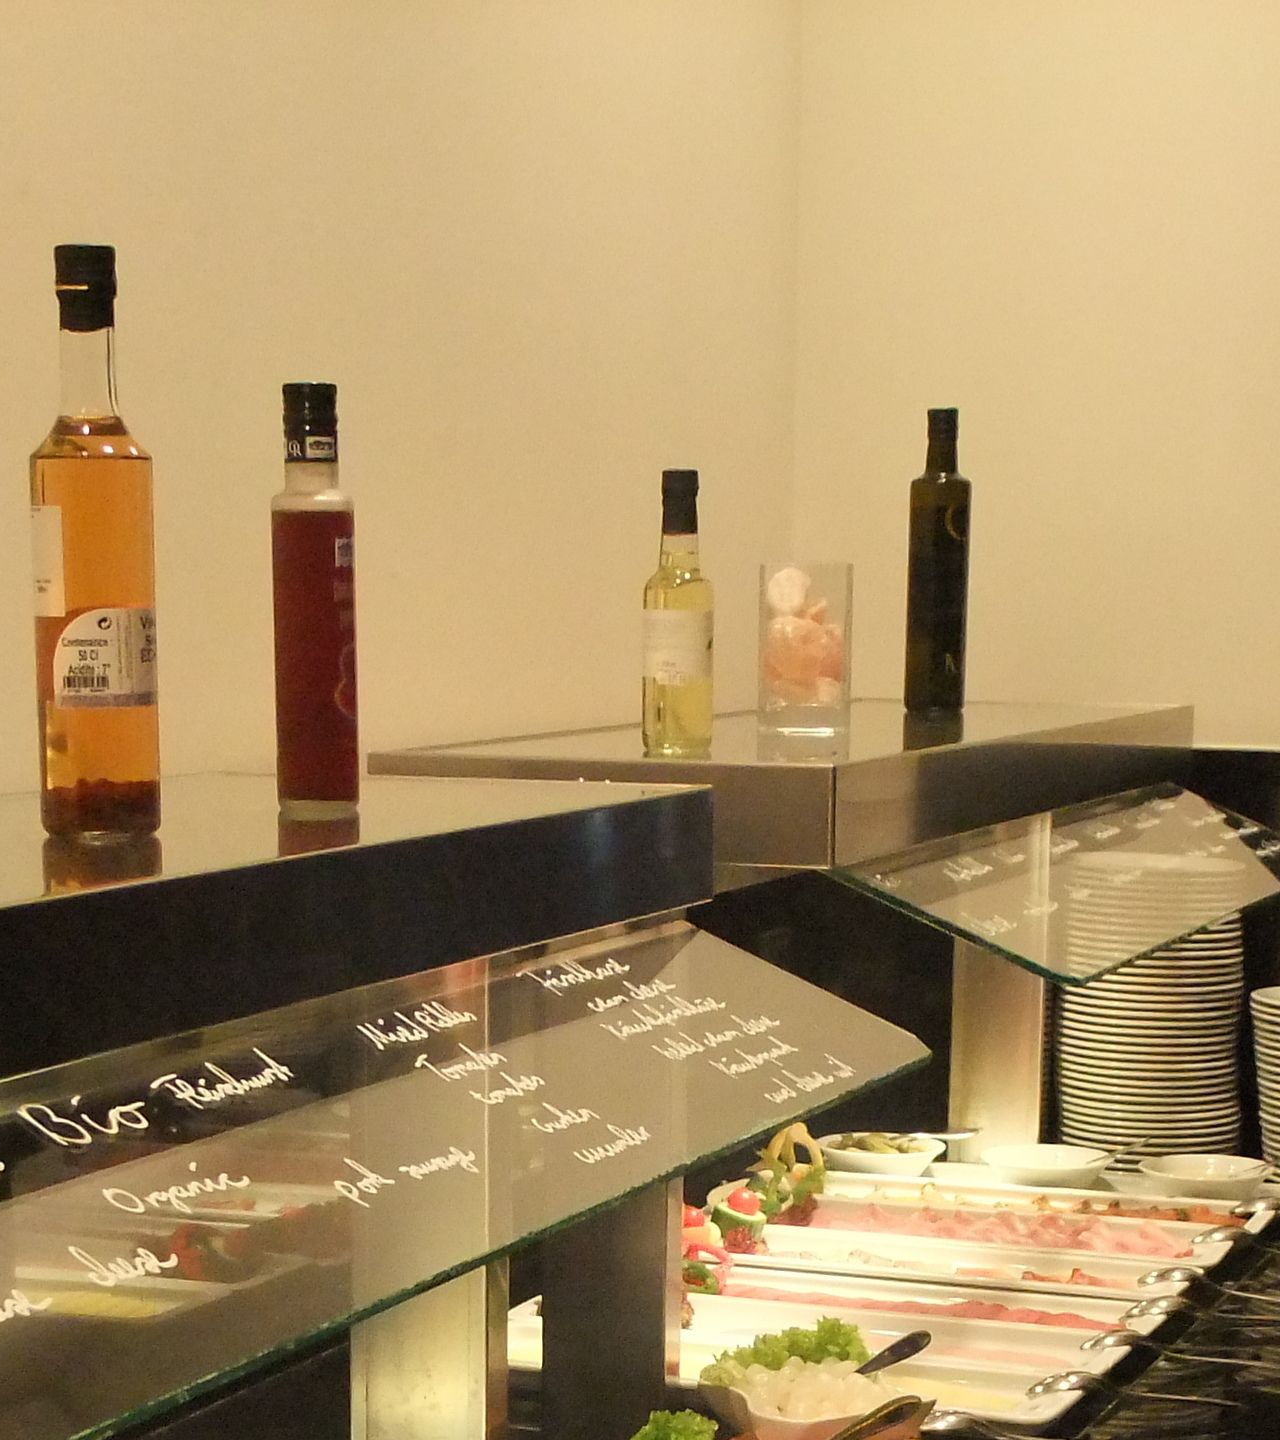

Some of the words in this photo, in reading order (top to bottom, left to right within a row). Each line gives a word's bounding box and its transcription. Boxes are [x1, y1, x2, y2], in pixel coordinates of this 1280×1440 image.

[413, 1041, 508, 1082] Tomaten
[16, 1094, 150, 1147] Bio
[102, 1160, 252, 1215] Organic
[333, 1156, 396, 1208] Pork
